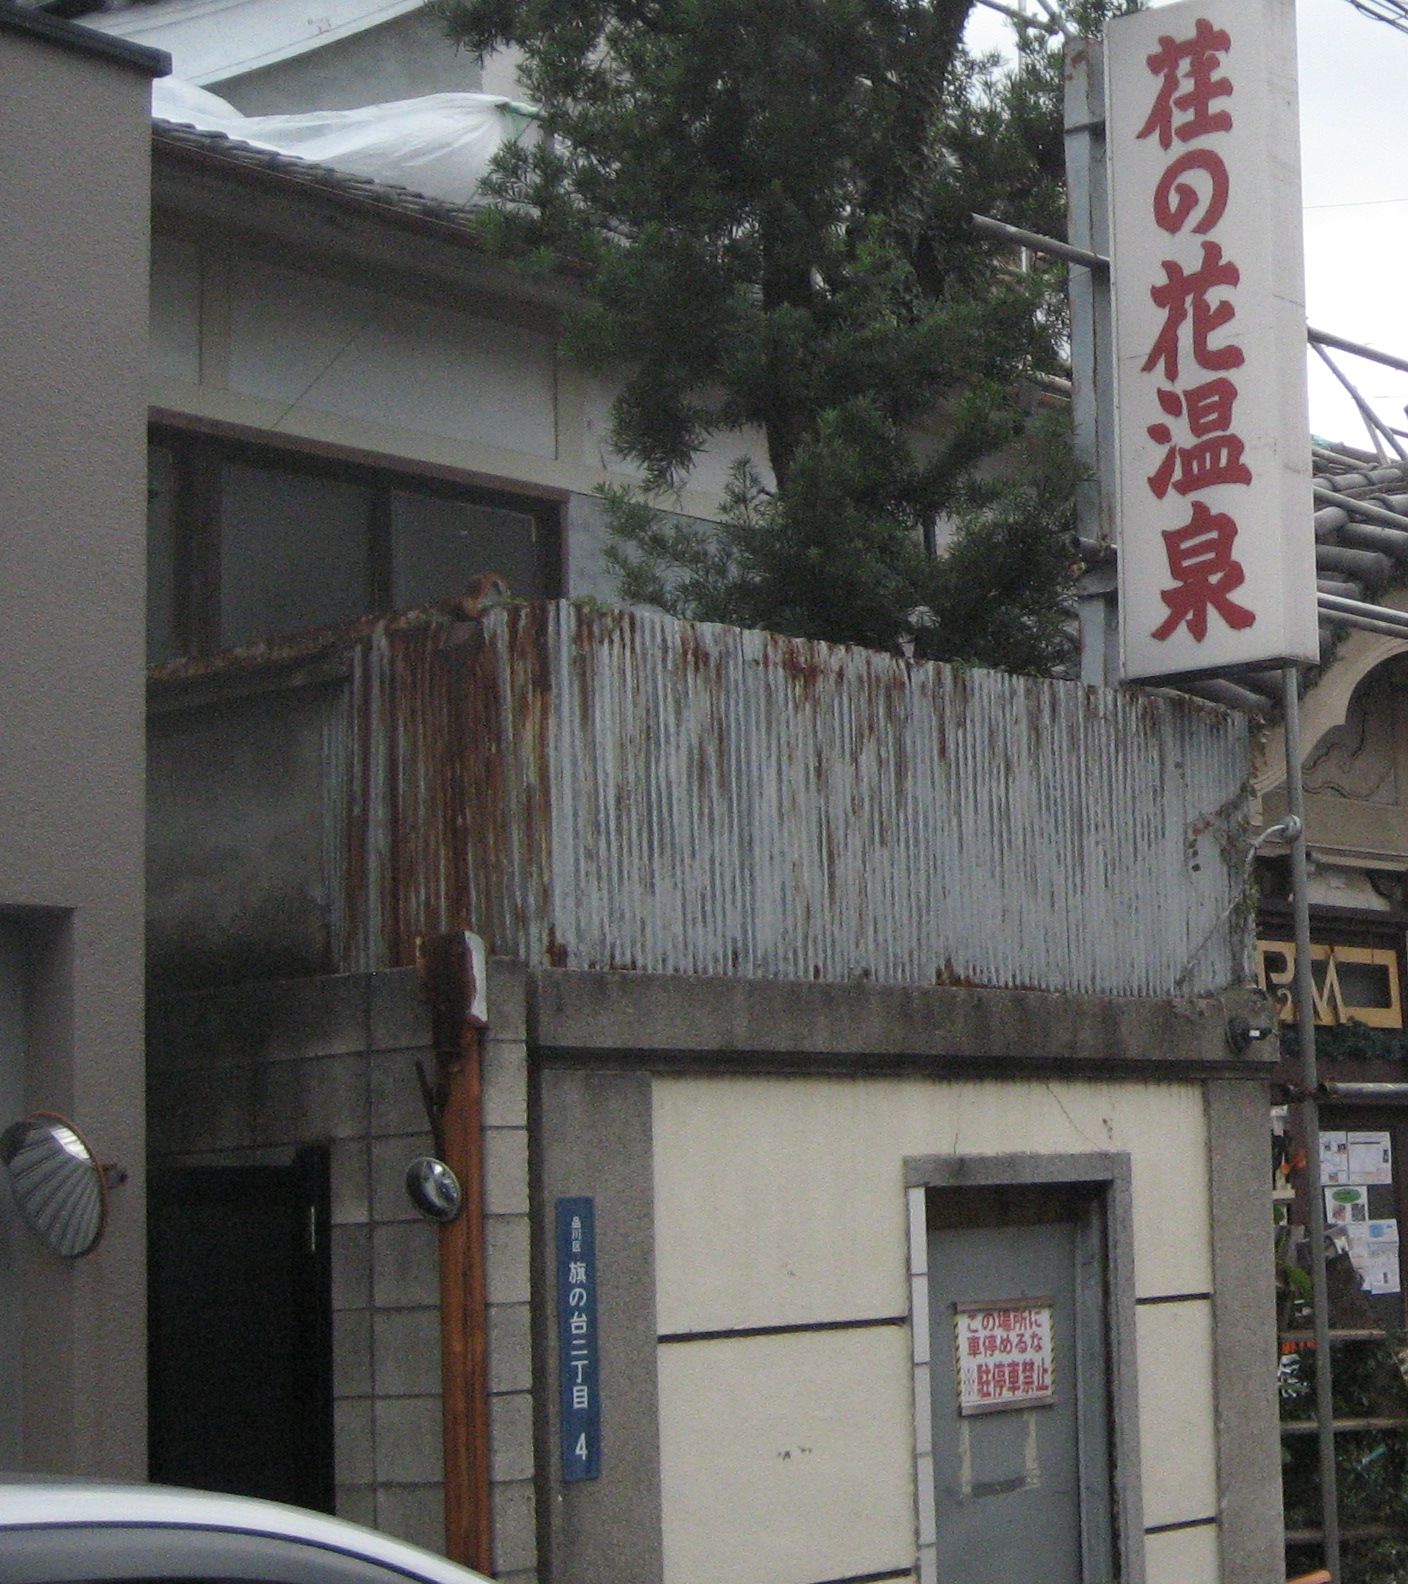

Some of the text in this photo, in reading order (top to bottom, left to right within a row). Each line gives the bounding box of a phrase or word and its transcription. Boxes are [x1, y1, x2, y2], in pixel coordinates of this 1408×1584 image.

[1136, 18, 1256, 642] 荏の花温泉
[568, 1215, 589, 1460] 品川区 旗の台二丁目 4
[967, 1309, 1042, 1333] この場所に
[967, 1330, 1042, 1358] 車停めるな
